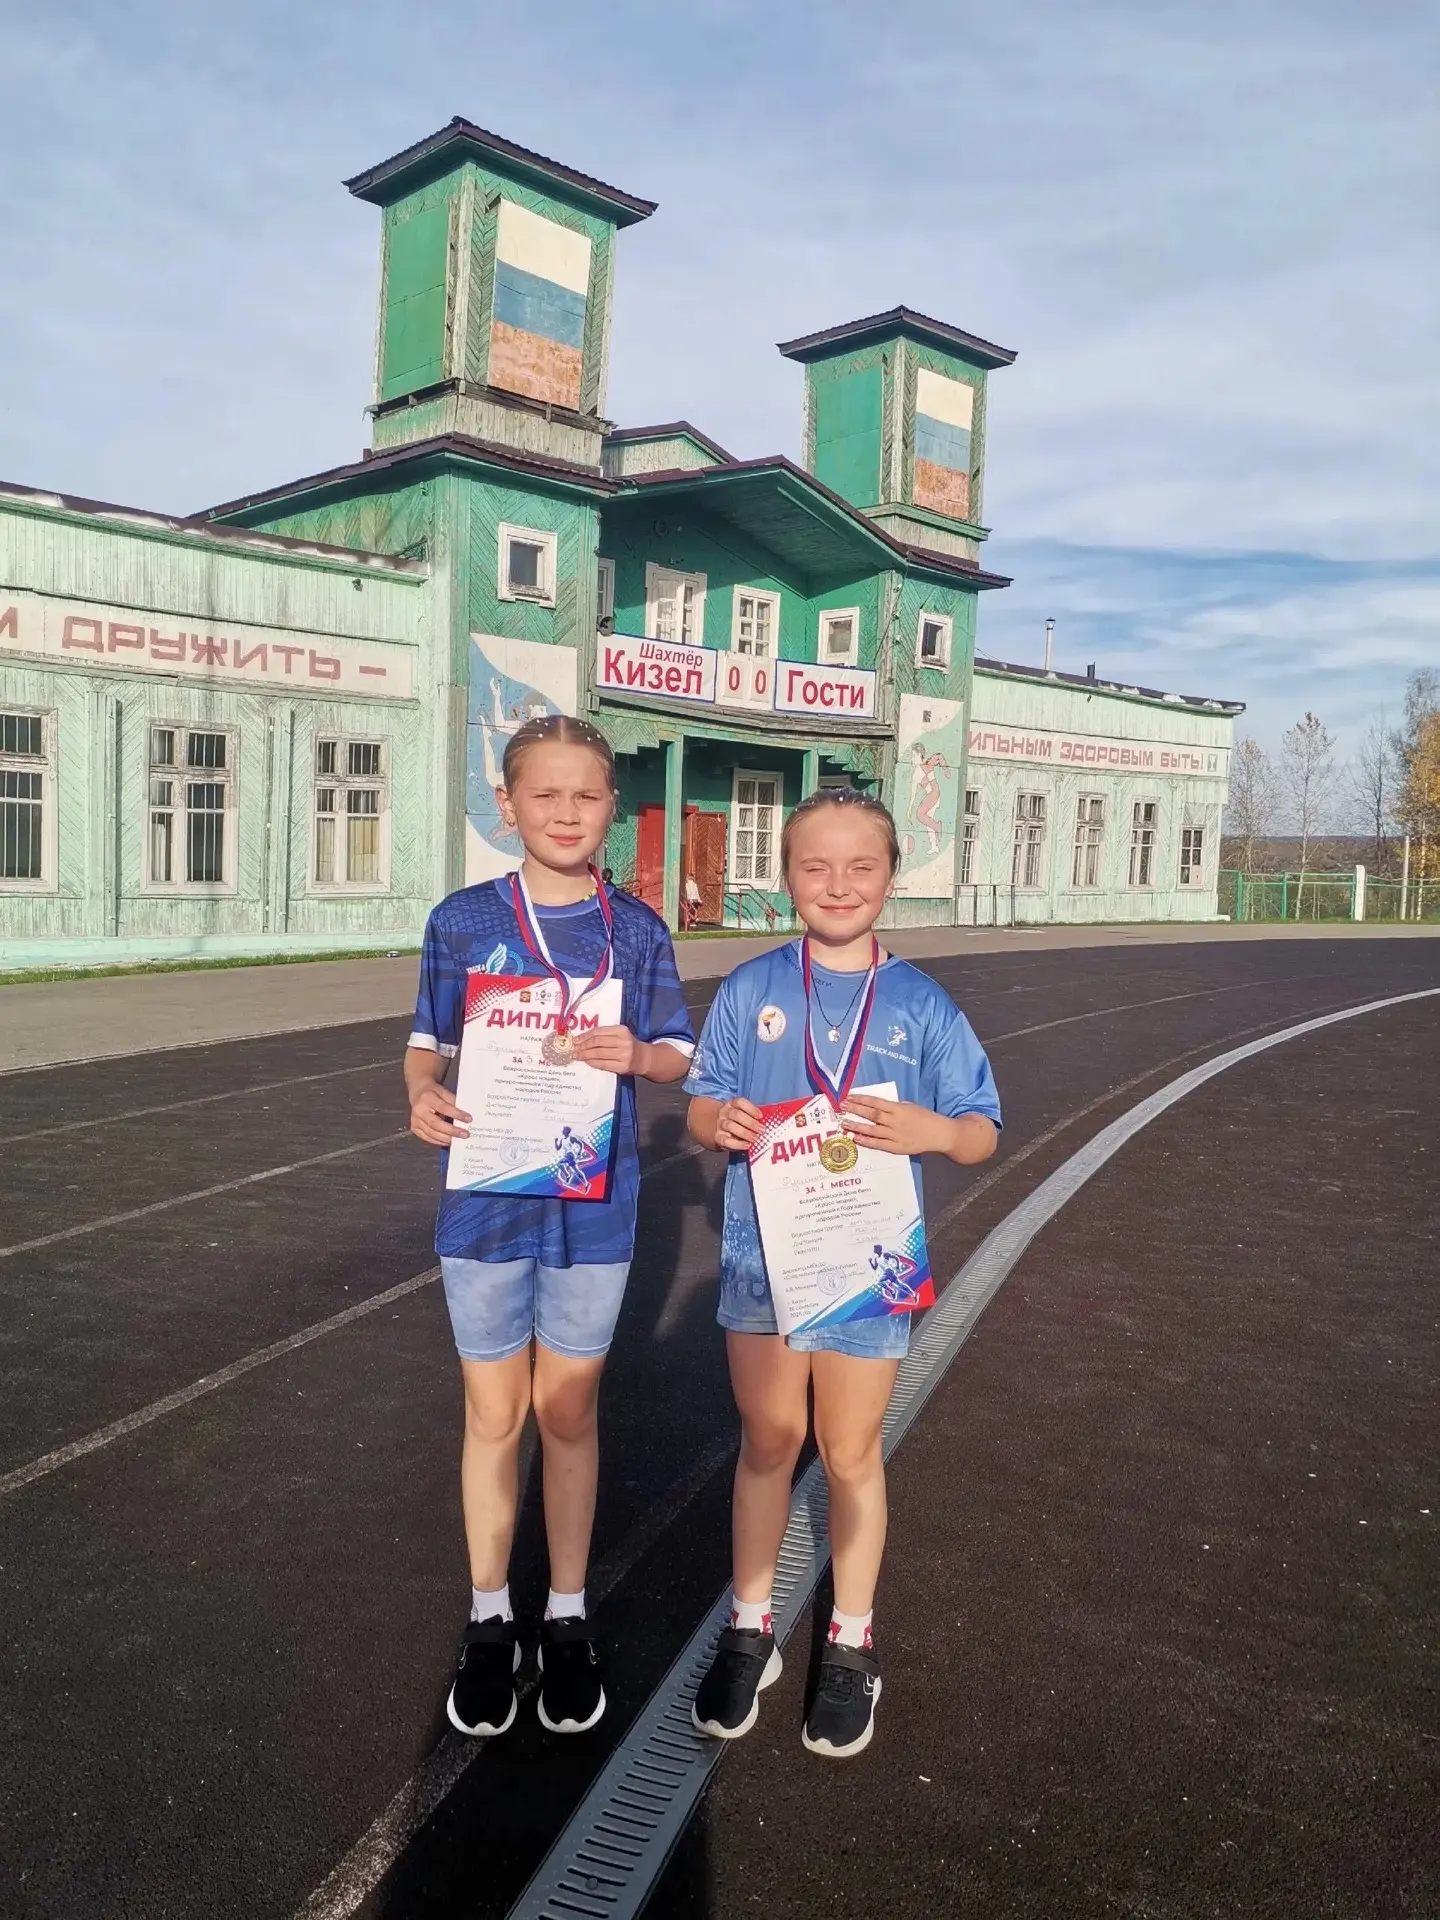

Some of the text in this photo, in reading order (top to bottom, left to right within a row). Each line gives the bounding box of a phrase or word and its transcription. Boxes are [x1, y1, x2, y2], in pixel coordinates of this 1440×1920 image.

[62, 615, 342, 680] ДРУЖИТЬ
[640, 642, 703, 668] Шахтёр
[604, 647, 703, 695] Кизел
[728, 666, 767, 694] 0 0
[788, 669, 865, 708] Гости
[1060, 741, 1153, 766] ЗДОРОВЫМ
[559, 1038, 567, 1047] 3
[866, 1044, 918, 1066] TRACK AND FIELD
[805, 1186, 816, 1195] ЗА
[830, 1177, 862, 1189] МЕСТО
